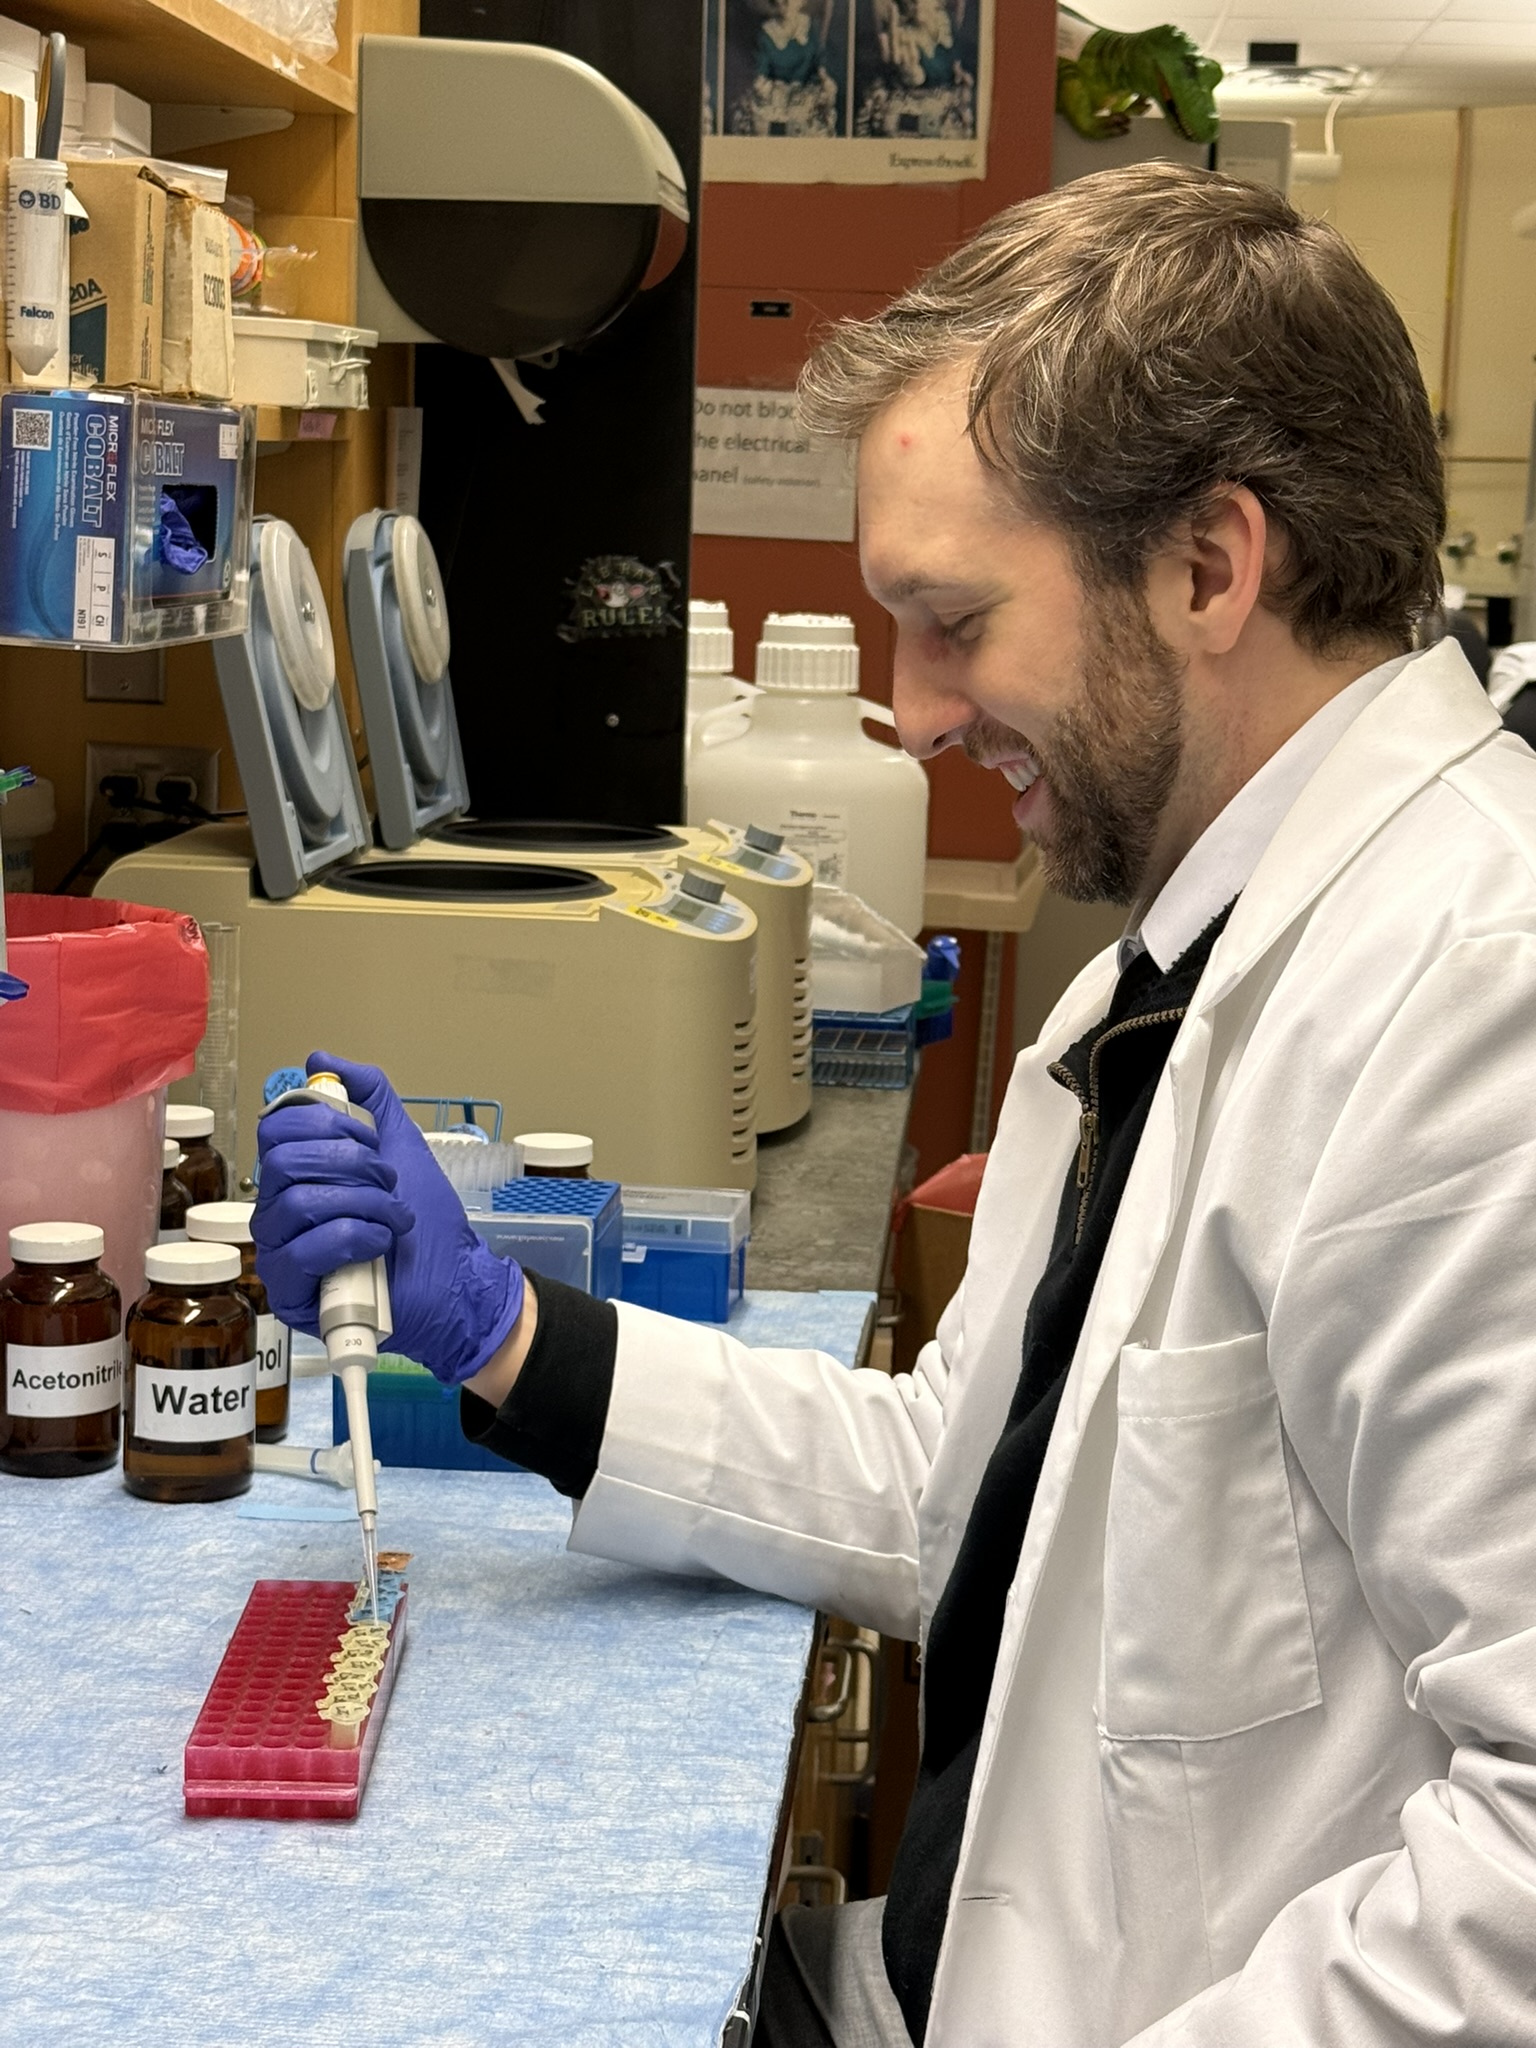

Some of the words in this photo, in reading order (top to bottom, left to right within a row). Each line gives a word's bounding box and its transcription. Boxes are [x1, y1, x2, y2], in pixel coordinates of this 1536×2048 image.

[38, 192, 61, 211] BD
[20, 306, 54, 320] Falcon
[719, 402, 752, 417] not
[758, 401, 797, 419] bloc
[724, 433, 810, 453] electrical
[82, 414, 107, 529] COBALT
[151, 1382, 250, 1416] Water
